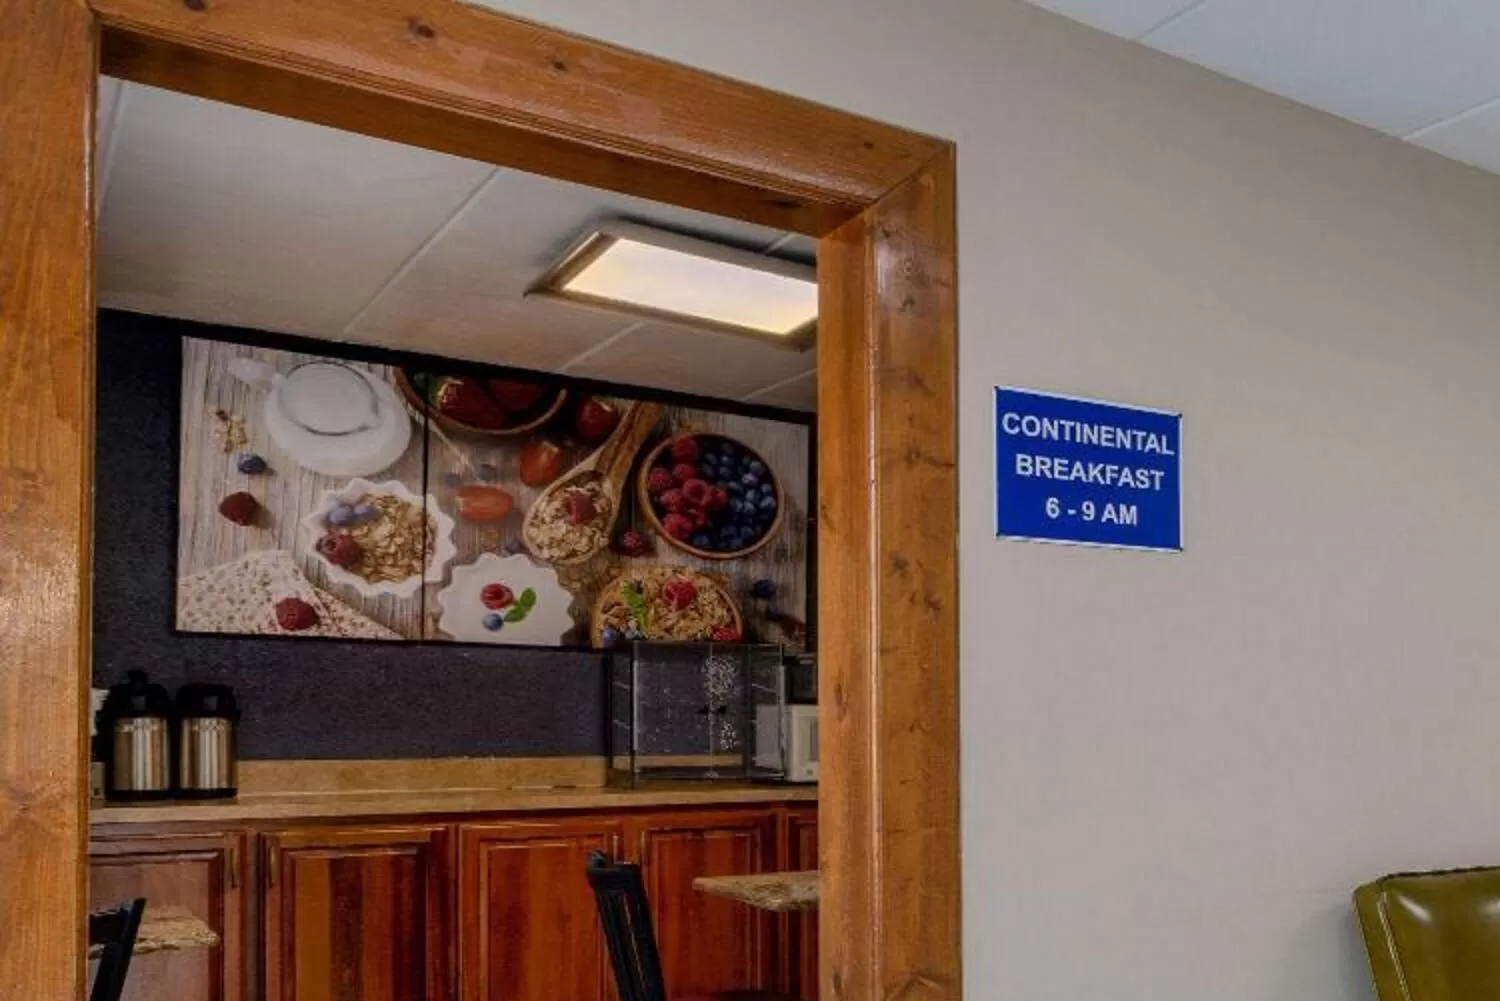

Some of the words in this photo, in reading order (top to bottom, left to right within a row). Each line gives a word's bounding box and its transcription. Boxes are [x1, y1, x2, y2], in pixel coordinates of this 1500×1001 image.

[1002, 413, 1175, 455] CONTINENTAL
[1015, 454, 1165, 490] BREAKFAST
[1101, 503, 1138, 526] AM
